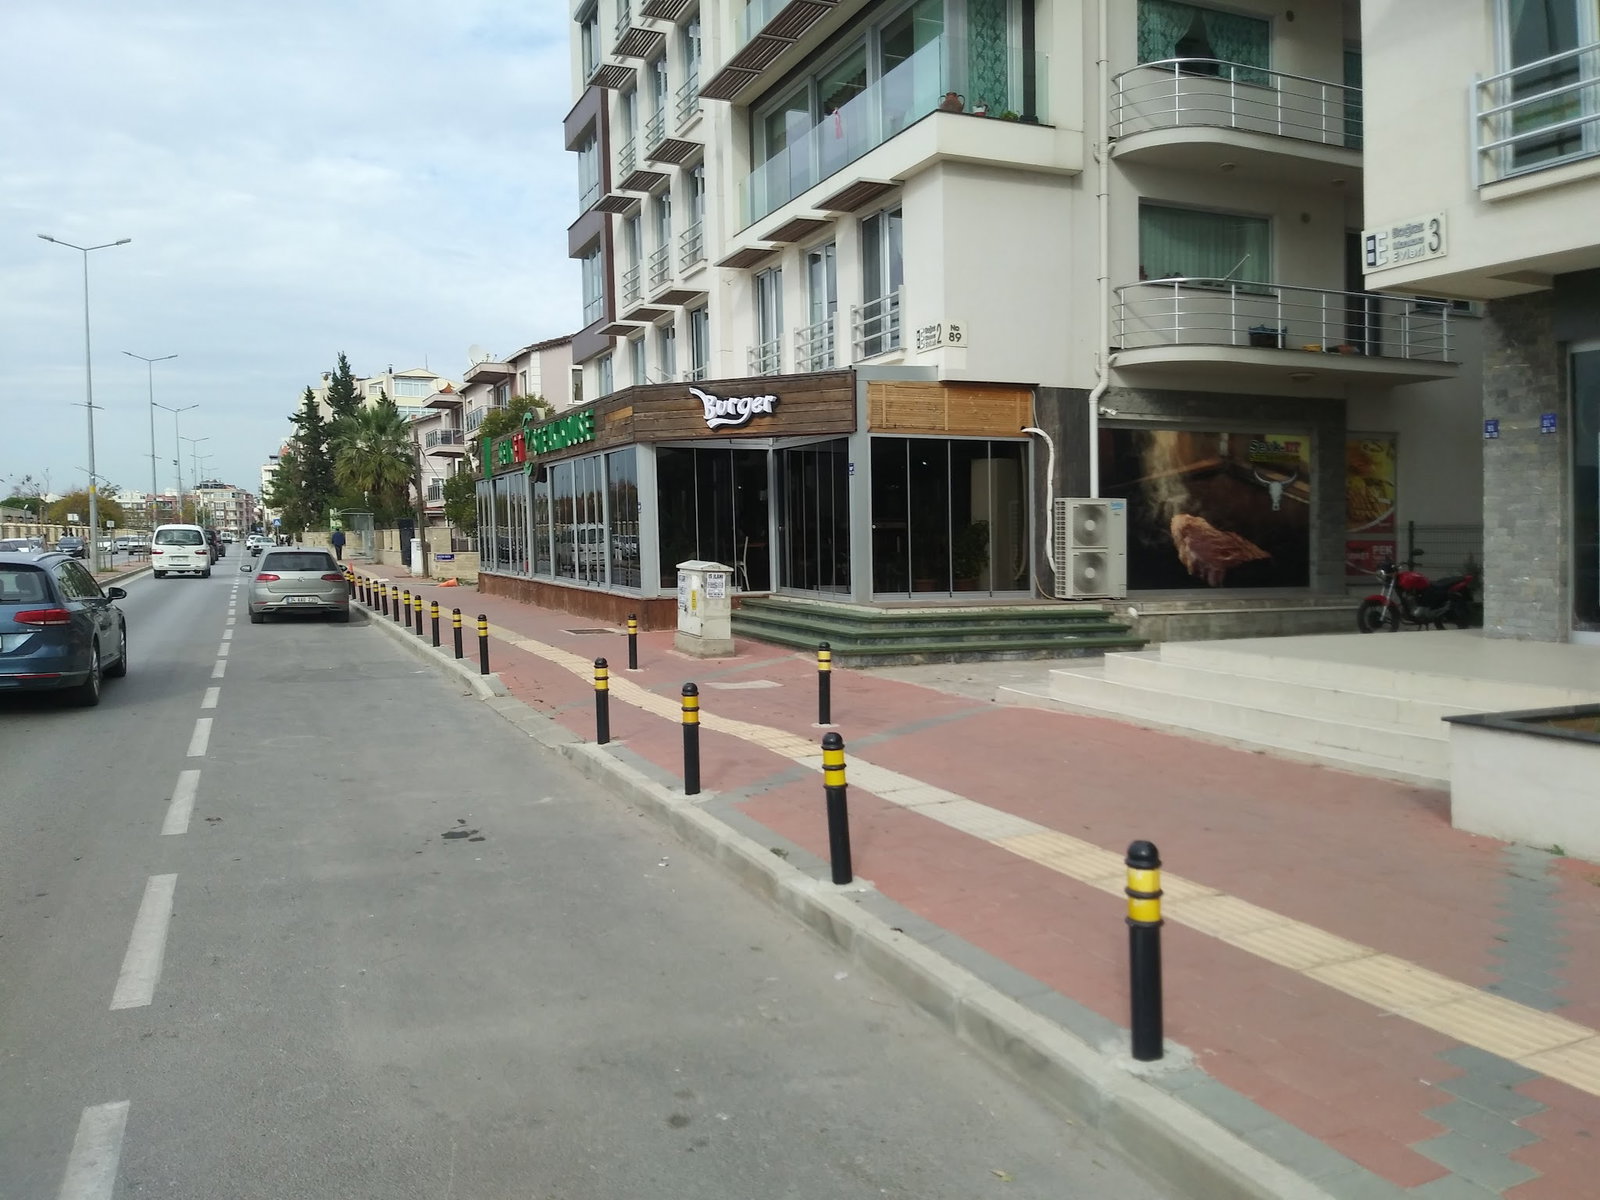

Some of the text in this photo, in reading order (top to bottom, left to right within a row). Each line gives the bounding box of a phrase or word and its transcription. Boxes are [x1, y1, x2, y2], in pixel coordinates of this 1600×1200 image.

[1429, 218, 1441, 253] 3
[949, 332, 962, 343] 89
[950, 324, 960, 332] No
[689, 387, 778, 429] Burger
